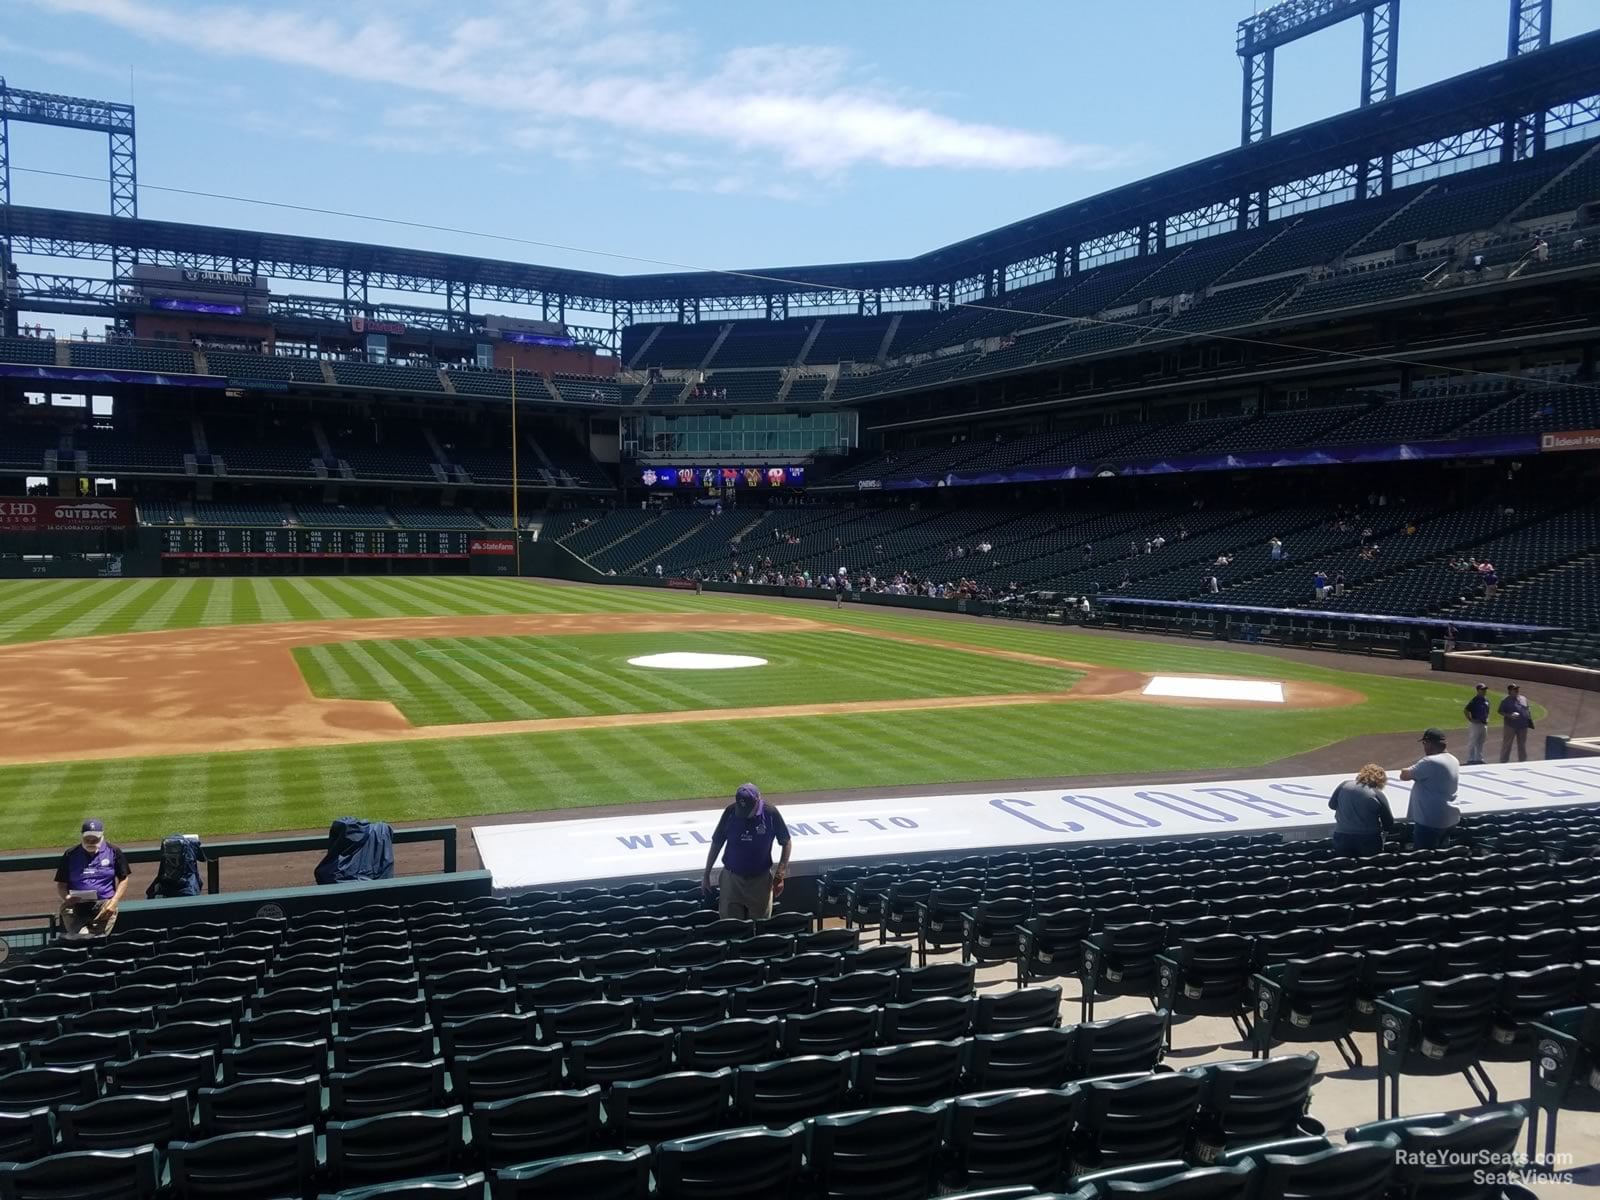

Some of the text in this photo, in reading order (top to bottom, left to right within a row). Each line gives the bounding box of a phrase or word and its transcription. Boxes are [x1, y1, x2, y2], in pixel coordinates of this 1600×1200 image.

[1555, 436, 1583, 447] Ideal
[9, 503, 37, 515] HD
[54, 510, 118, 519] OUTBACK
[616, 816, 920, 850] WELME TO
